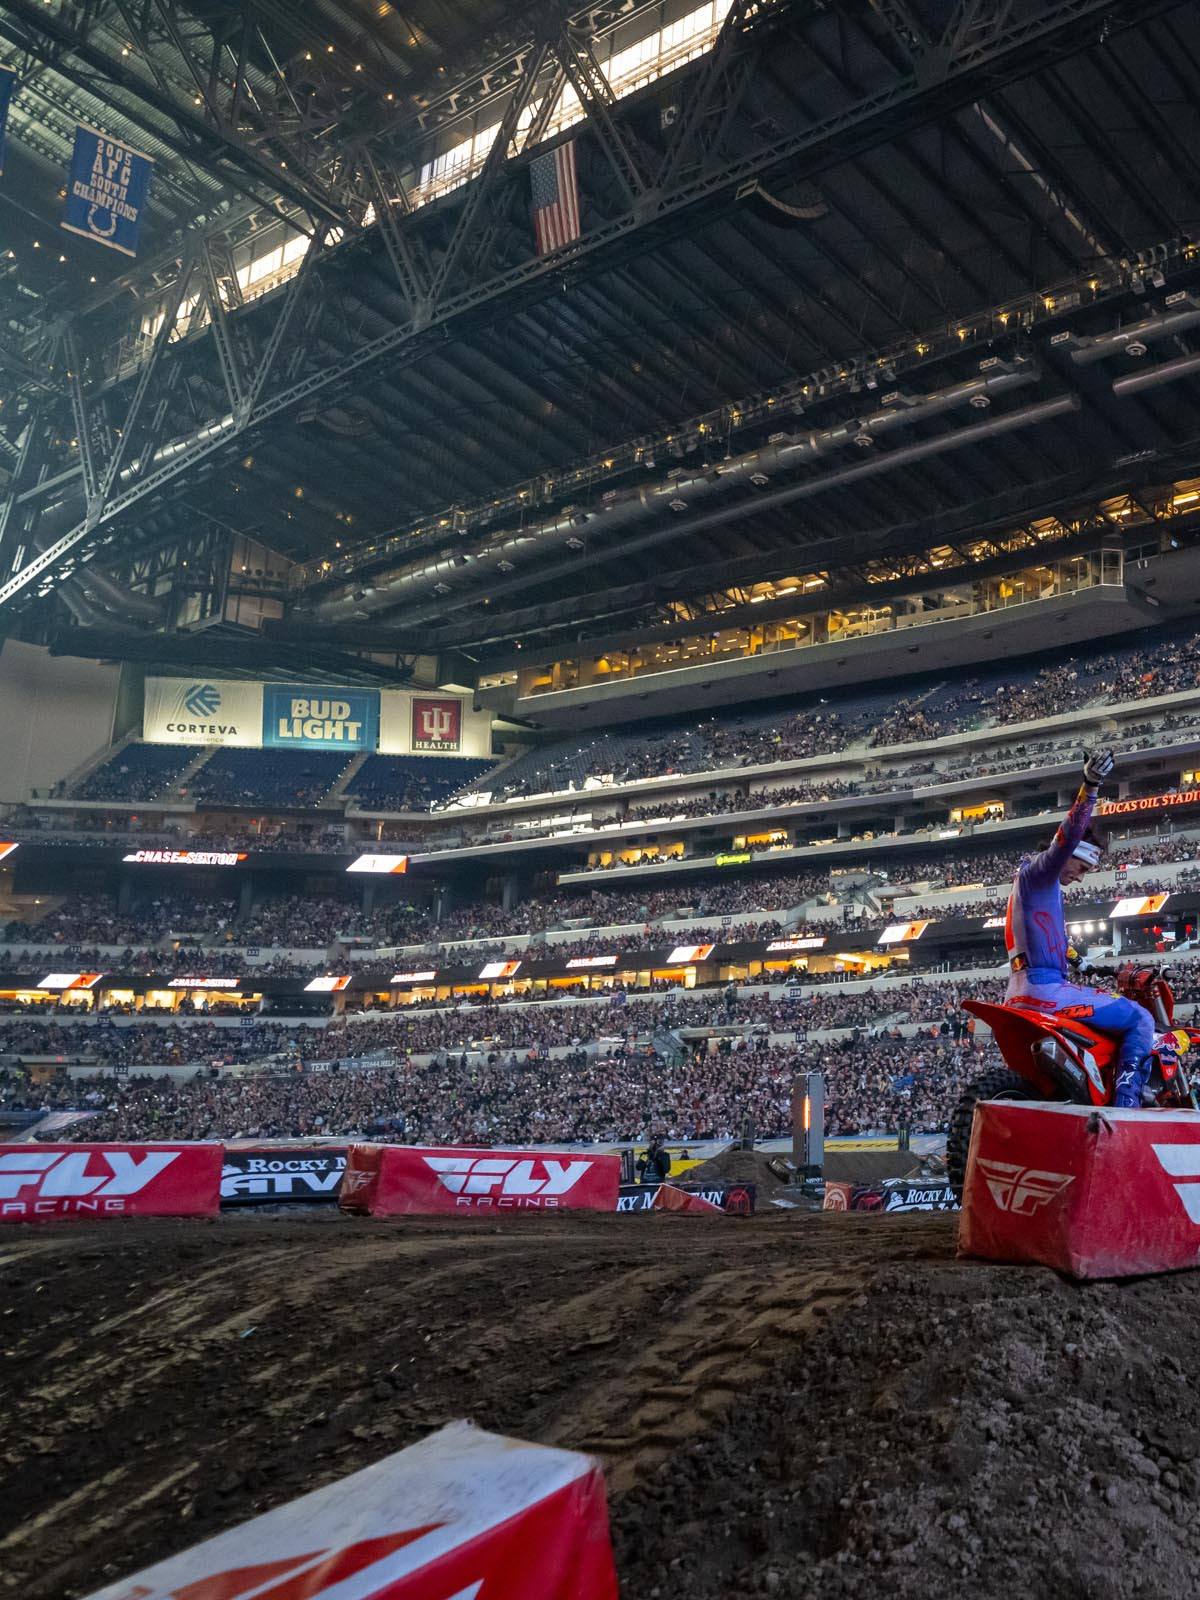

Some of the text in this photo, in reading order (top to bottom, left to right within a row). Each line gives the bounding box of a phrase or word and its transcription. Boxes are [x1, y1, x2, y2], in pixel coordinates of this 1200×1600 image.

[97, 140, 132, 166] 2005
[93, 154, 131, 186] AFC
[90, 173, 127, 201] SOUTH
[73, 180, 138, 222] CHAMPIONS
[291, 699, 351, 721] BUD
[167, 722, 237, 735] CORTEVA
[279, 718, 362, 742] LIGHT
[415, 741, 458, 750] HEALTH
[1102, 800, 1137, 815] LUCAS
[1139, 797, 1160, 810] OIL
[135, 850, 180, 864] CHASE
[0, 1152, 182, 1198] FLY
[247, 1156, 330, 1174] ROCKY
[422, 1157, 594, 1195] FLY
[220, 1171, 343, 1198] ATV
[2, 1199, 125, 1215] ACING
[456, 1196, 559, 1207] RACING
[905, 1188, 941, 1204] ROCKY
